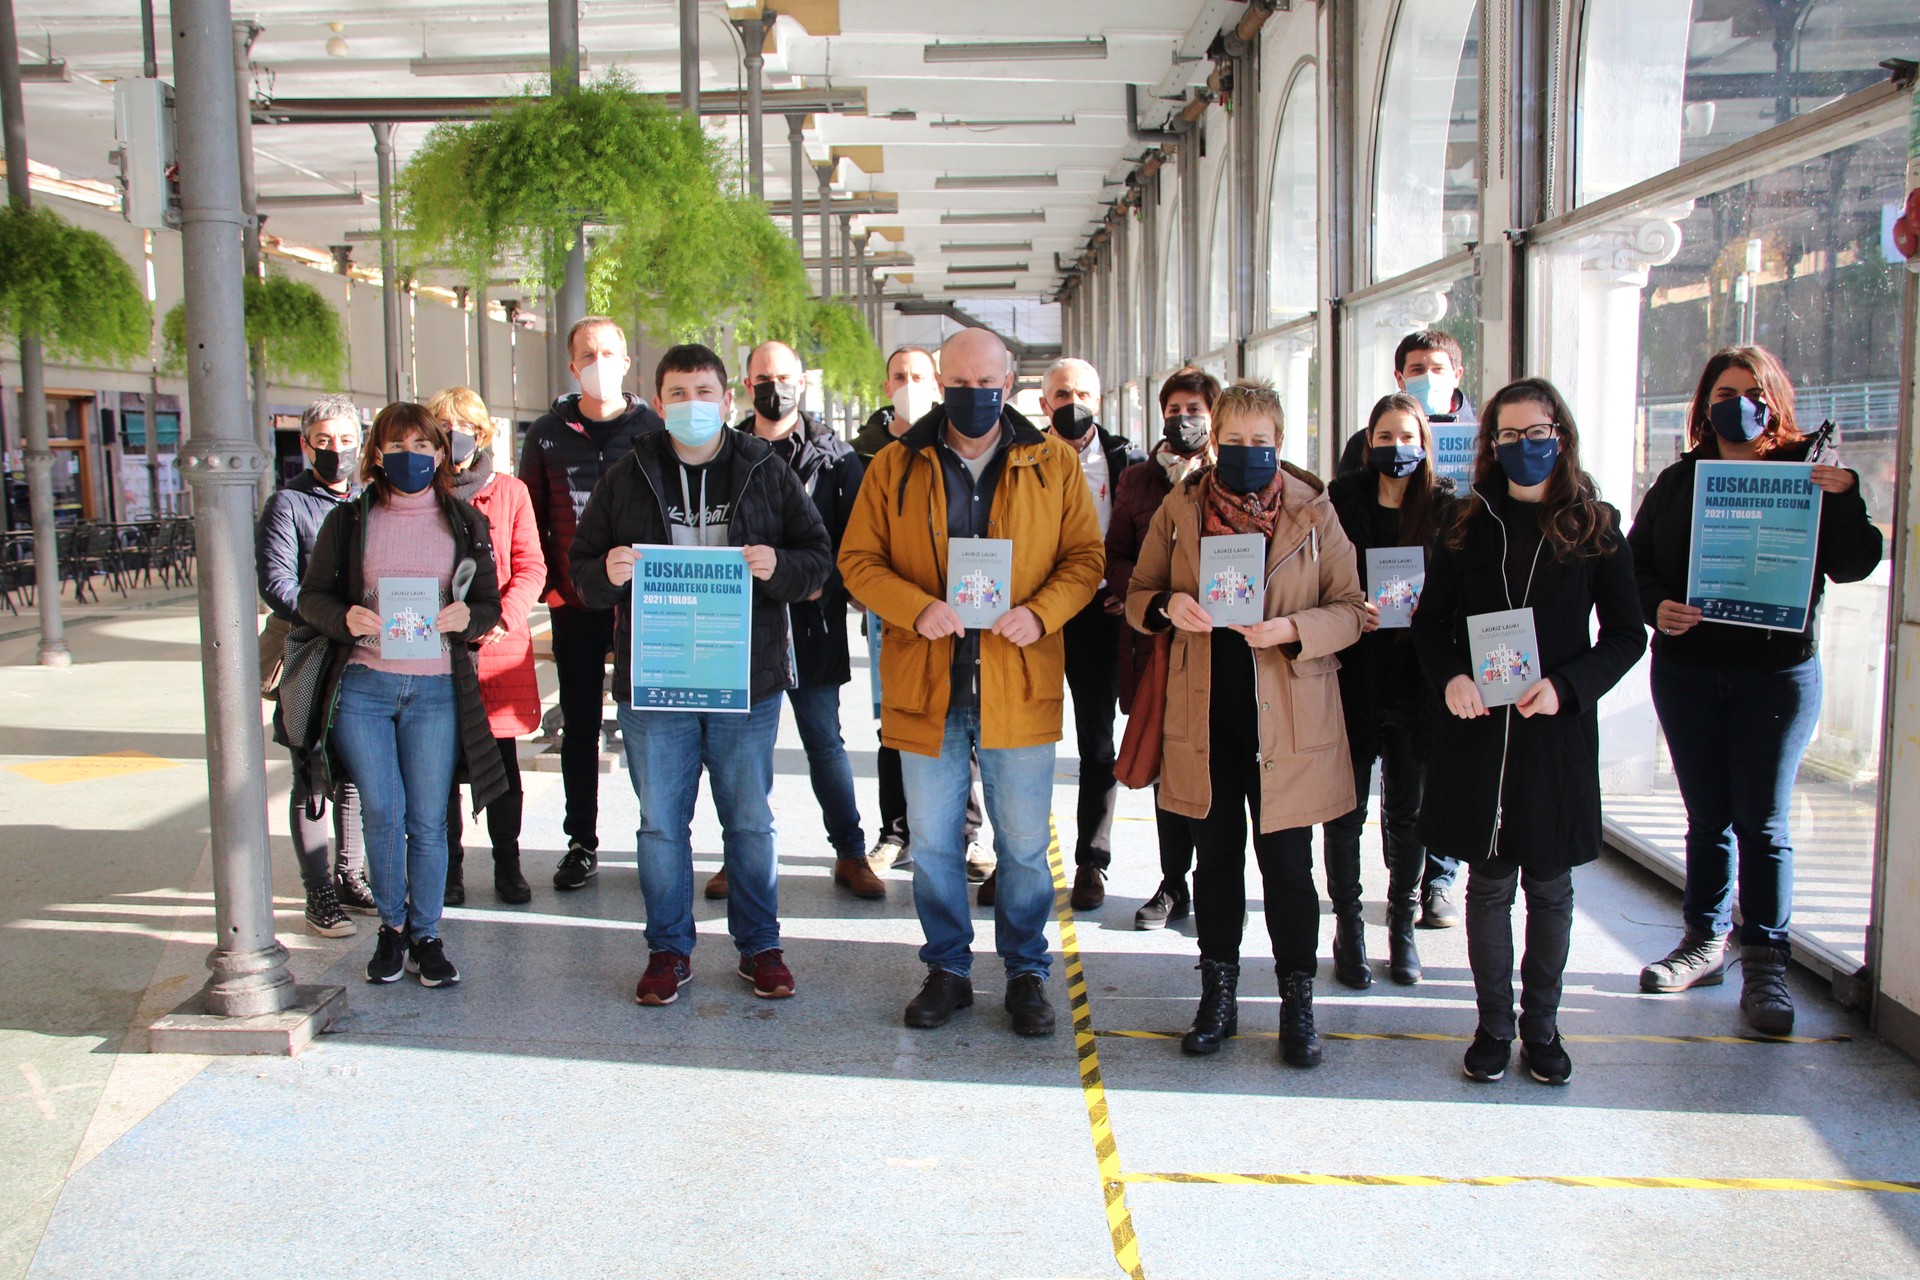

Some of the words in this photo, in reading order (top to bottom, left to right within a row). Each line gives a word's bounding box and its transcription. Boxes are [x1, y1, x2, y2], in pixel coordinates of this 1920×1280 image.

[1706, 476, 1813, 496] EUSKARAREN
[1705, 496, 1774, 509] NAZIOARTEKO
[1776, 498, 1810, 510] EGUNA
[1704, 509, 1726, 519] 2021
[1731, 509, 1762, 520] TOLOSA
[644, 561, 743, 580] EUSKARAREN
[643, 581, 709, 594] NAZIOARTEKO
[710, 583, 742, 594] EGUNA
[643, 595, 662, 604] 2021
[668, 596, 698, 605] TOLOSA
